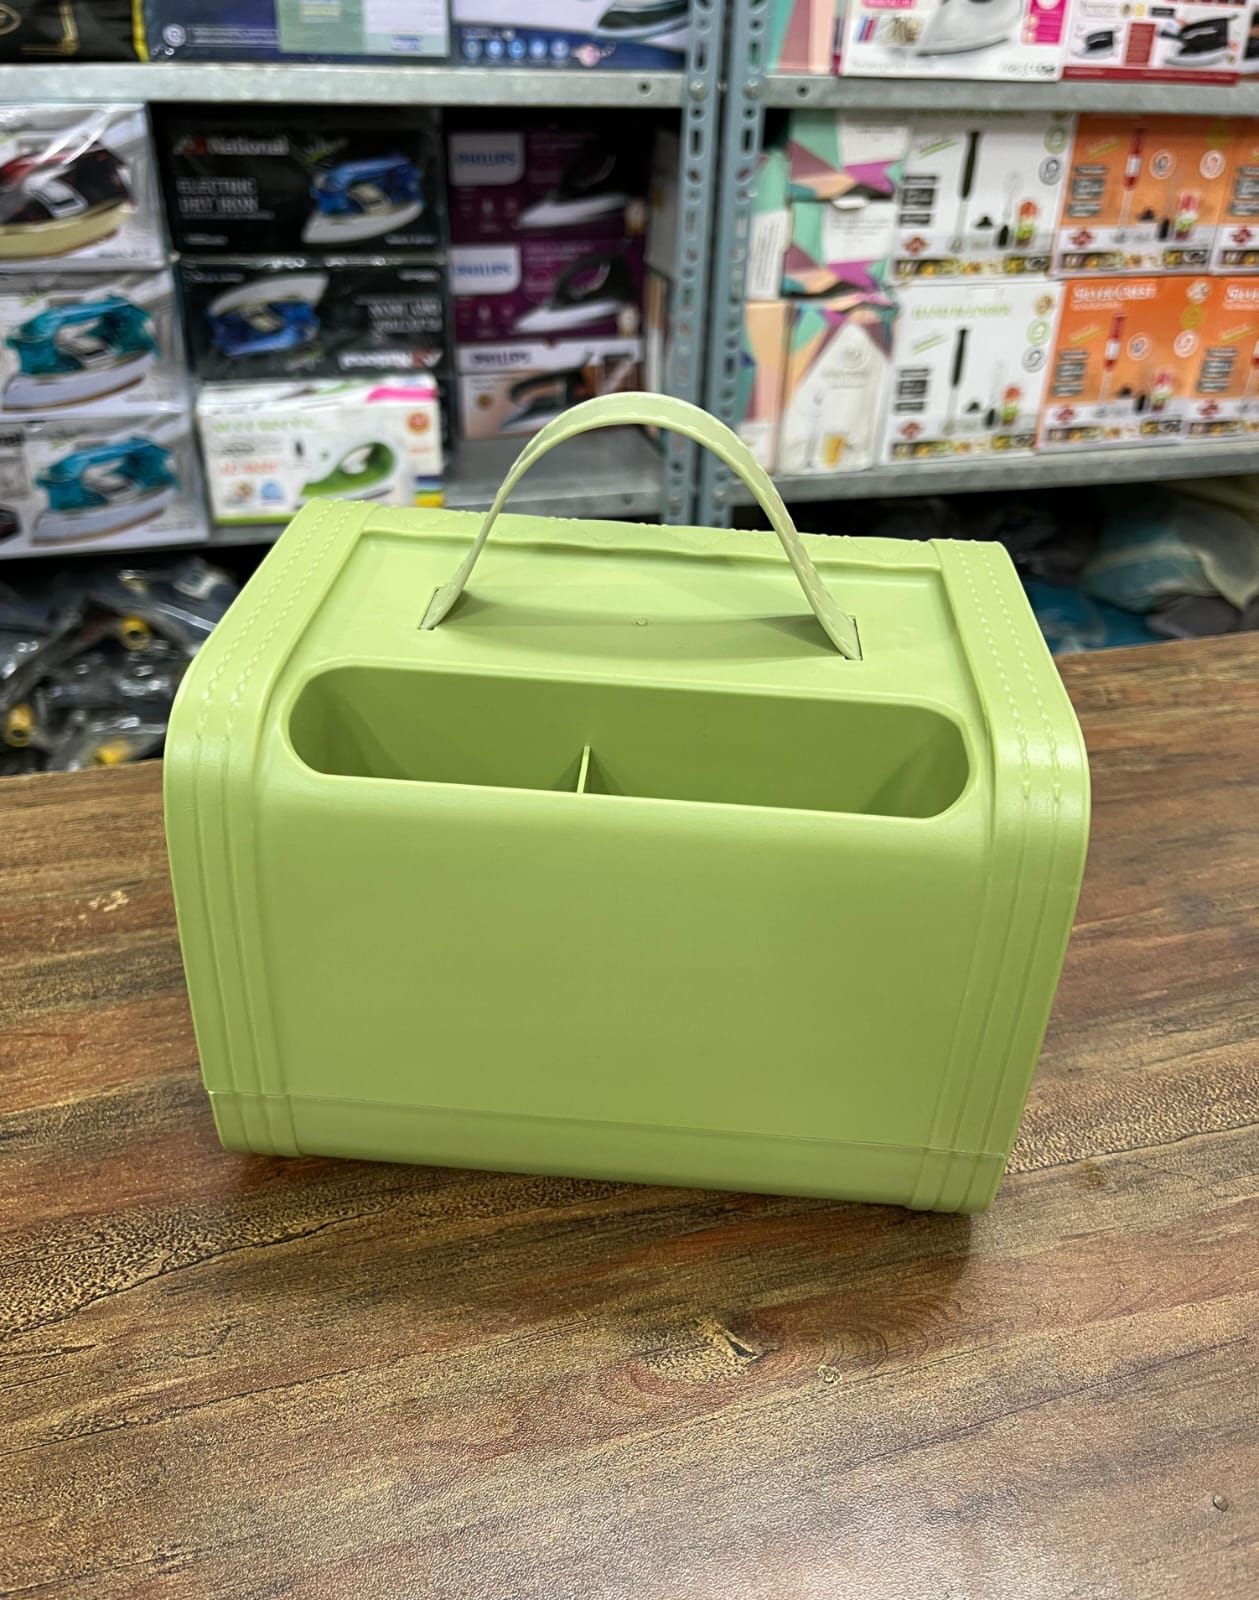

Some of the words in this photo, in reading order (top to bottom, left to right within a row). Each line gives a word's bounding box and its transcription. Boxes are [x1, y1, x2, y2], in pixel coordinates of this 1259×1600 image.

[456, 151, 518, 167] PHILIPS
[455, 262, 514, 277] PHILIPS
[471, 350, 532, 366] PHILIPS
